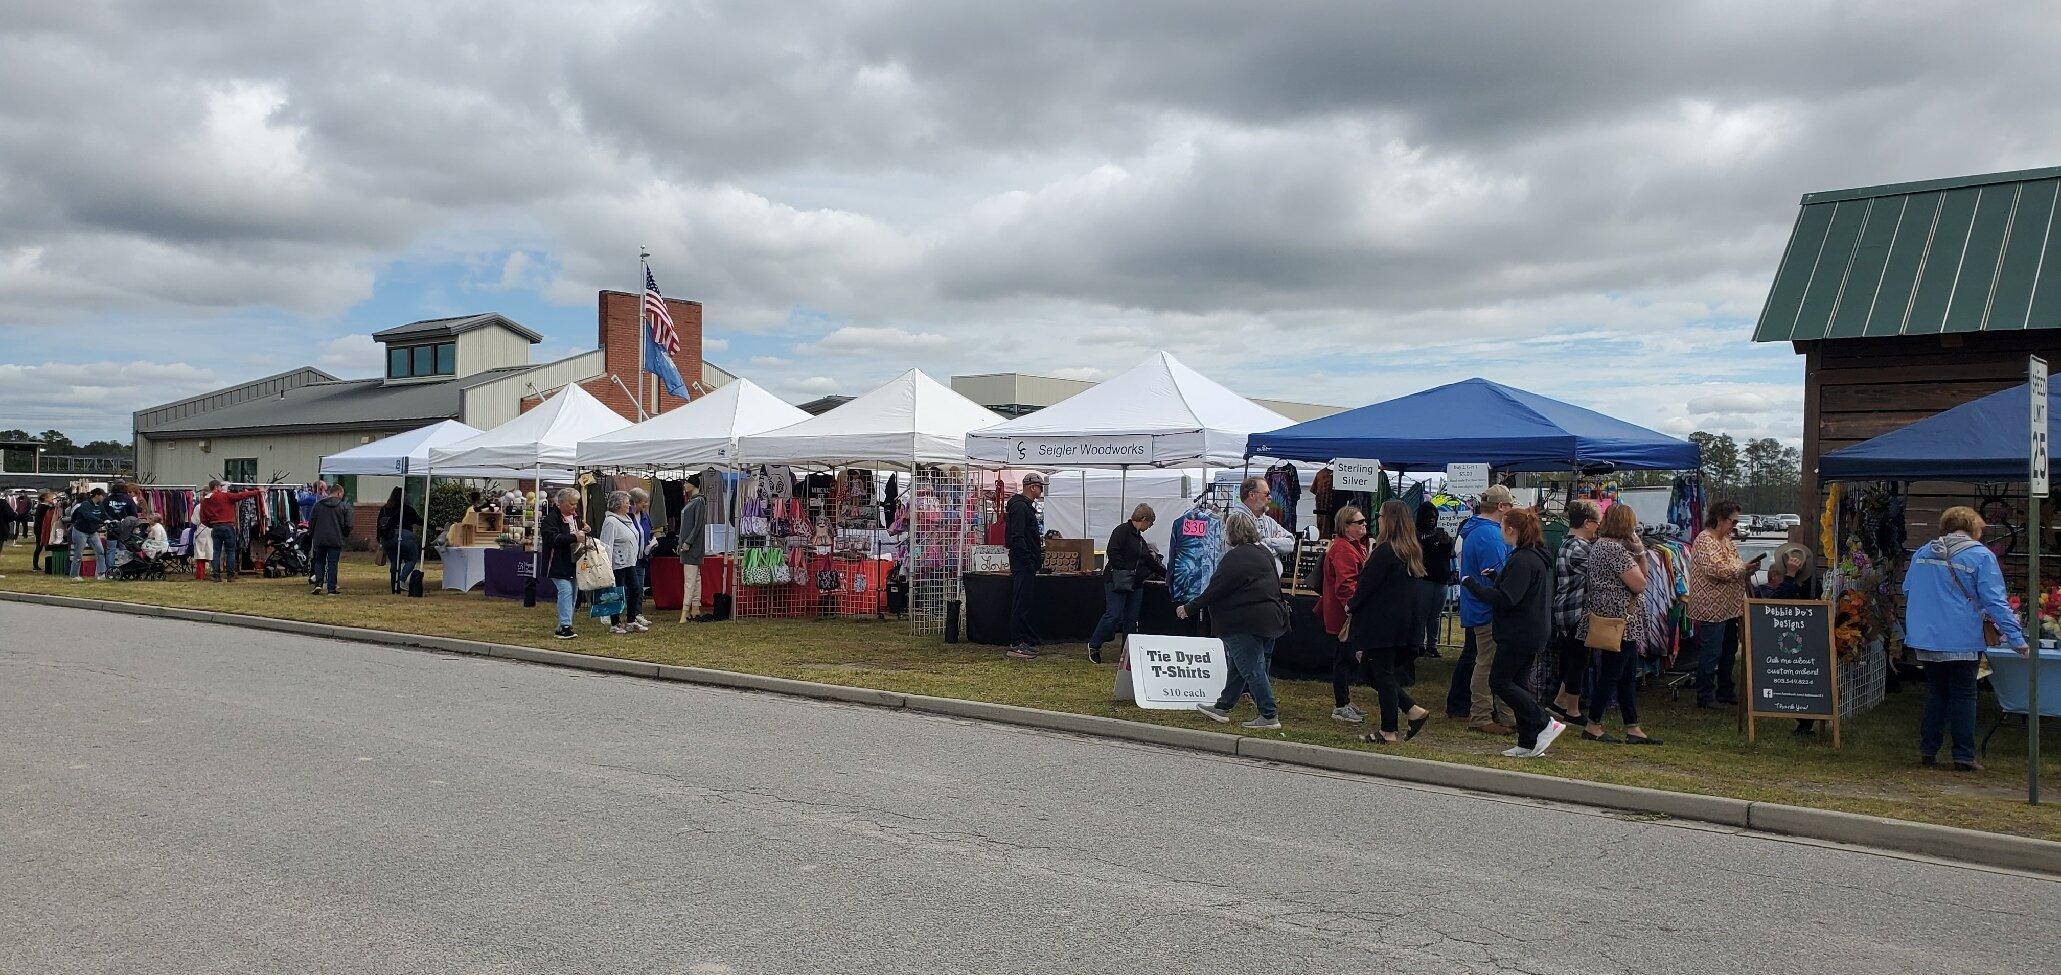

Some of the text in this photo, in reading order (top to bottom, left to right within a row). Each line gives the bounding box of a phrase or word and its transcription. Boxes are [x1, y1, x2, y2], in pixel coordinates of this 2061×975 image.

[1038, 443, 1145, 458] Seigler Woodworks
[2032, 431, 2047, 479] 25
[1338, 463, 1373, 475] Sterling
[1342, 476, 1368, 486] Silver
[1184, 520, 1205, 534] $30
[1765, 605, 1793, 617] Debbie
[1773, 617, 1805, 631] Designs
[1146, 650, 1212, 665] Tie Dyed
[1793, 656, 1815, 665] about
[1151, 665, 1211, 679] T-Shirts
[1766, 668, 1794, 676] custom
[1162, 687, 1206, 698] $10 each
